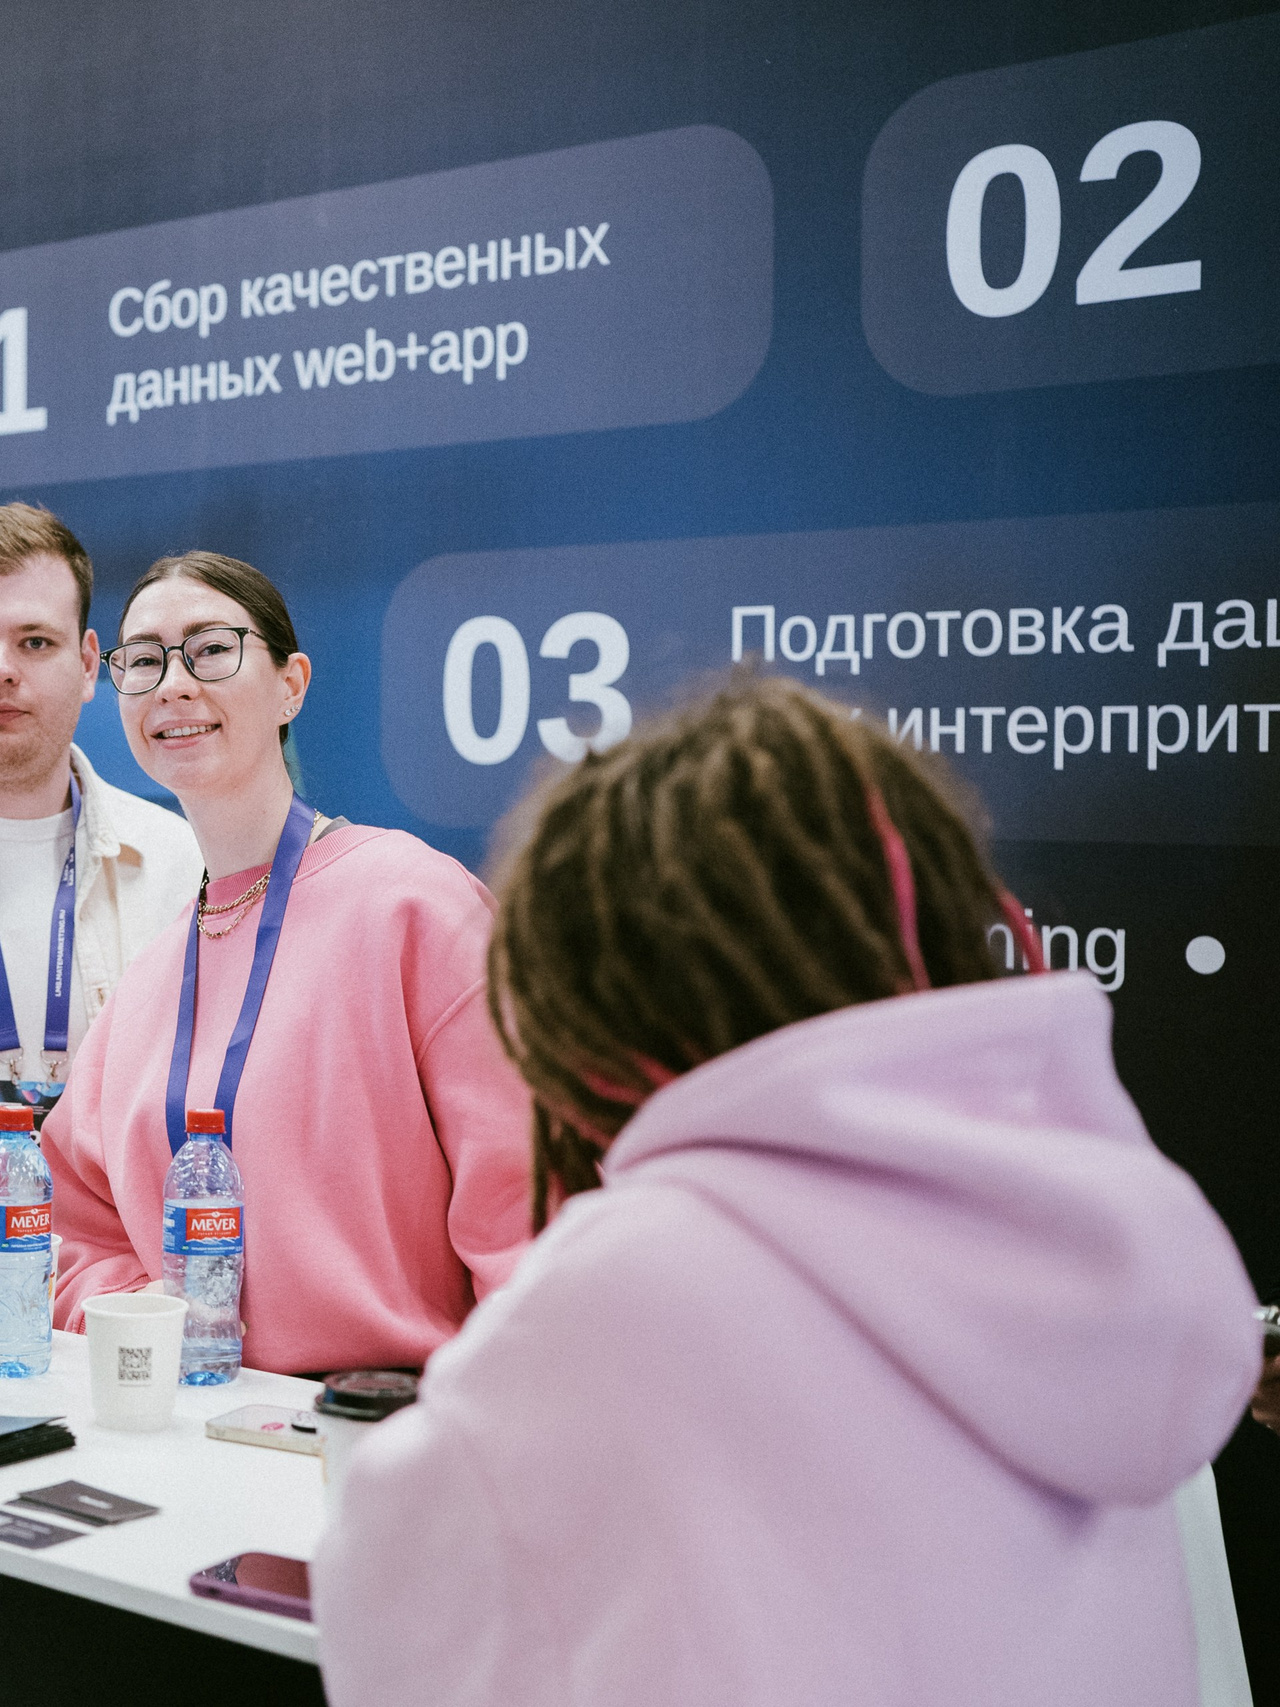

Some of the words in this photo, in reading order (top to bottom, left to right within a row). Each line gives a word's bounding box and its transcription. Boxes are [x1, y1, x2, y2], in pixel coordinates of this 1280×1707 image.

[945, 119, 1202, 318] 02
[108, 279, 228, 339] Сбор
[240, 222, 611, 319] качественных
[106, 353, 283, 426] данных
[293, 320, 530, 390] web+app
[730, 603, 1136, 677] Подготовка
[442, 610, 634, 766] 03
[885, 703, 1280, 772] интерприт
[10, 1213, 51, 1229] MEVER
[190, 1217, 237, 1232] MEVER
